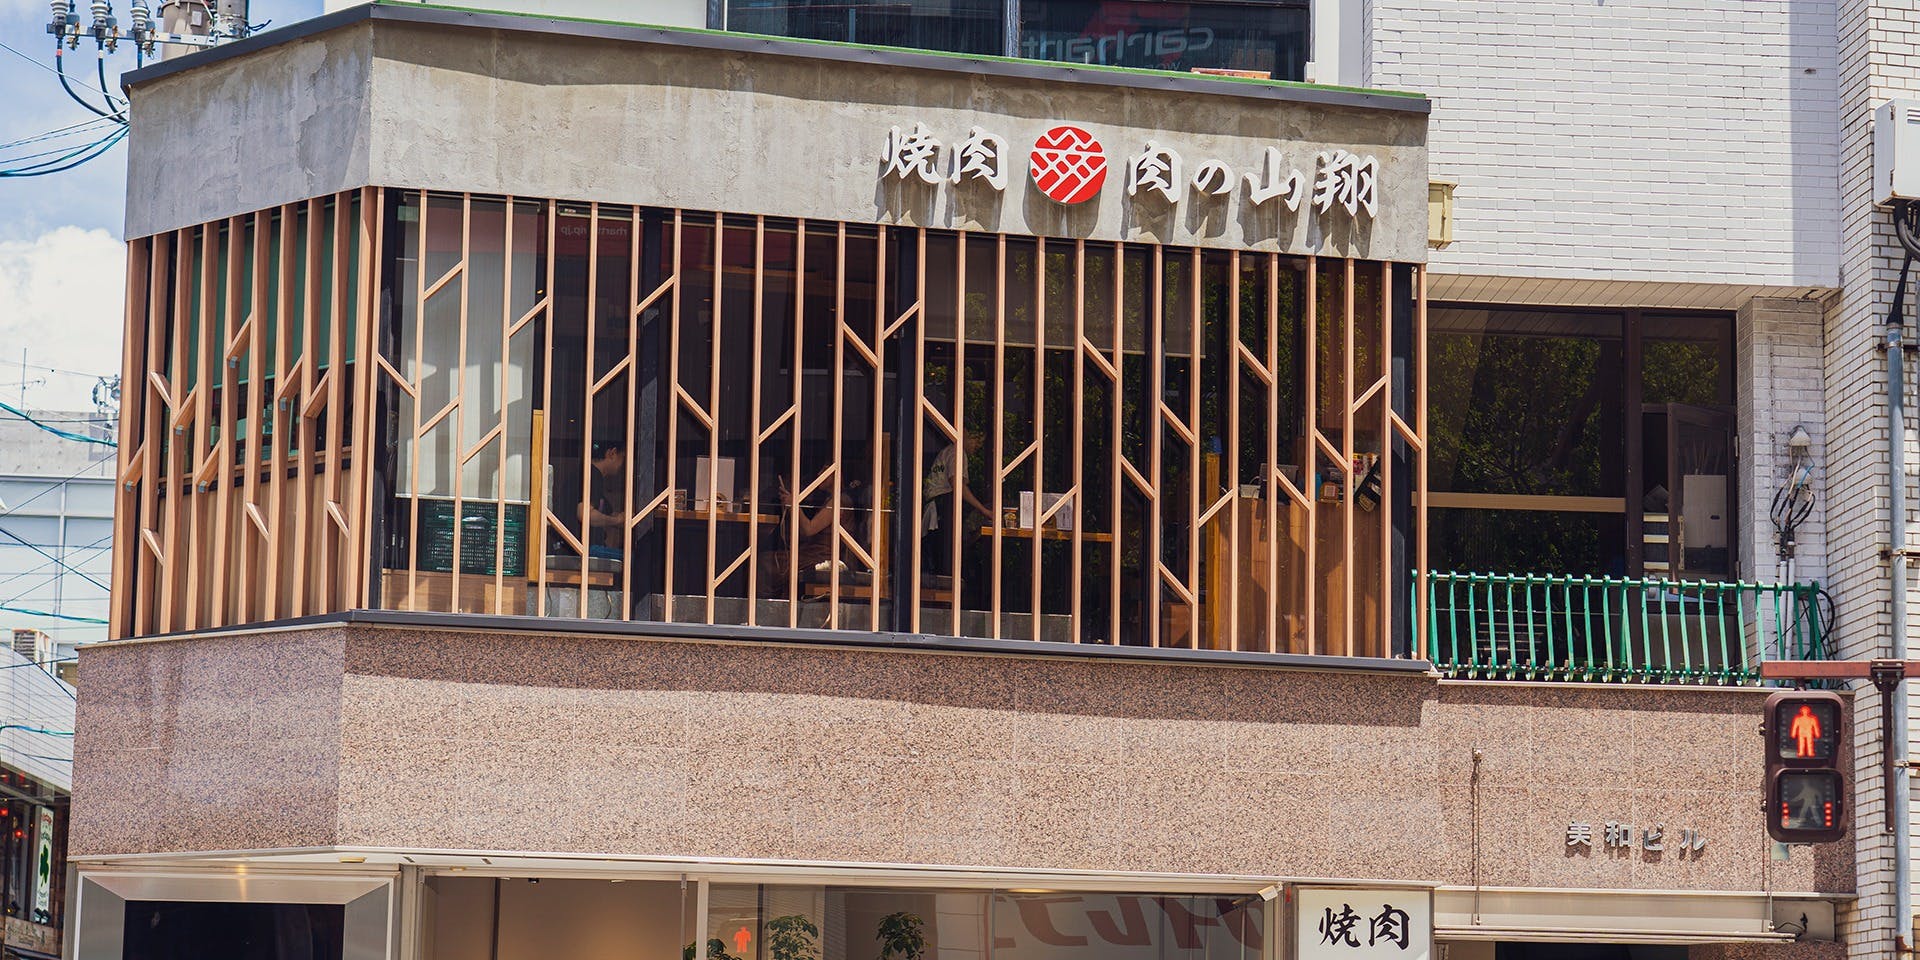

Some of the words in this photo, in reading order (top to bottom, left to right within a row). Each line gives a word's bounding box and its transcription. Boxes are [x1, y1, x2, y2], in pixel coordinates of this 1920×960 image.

[881, 121, 1010, 190] 焼肉
[1129, 139, 1379, 218] 肉の山翔
[1567, 820, 1705, 850] 美和ビル
[1319, 903, 1410, 950] 焼肉
